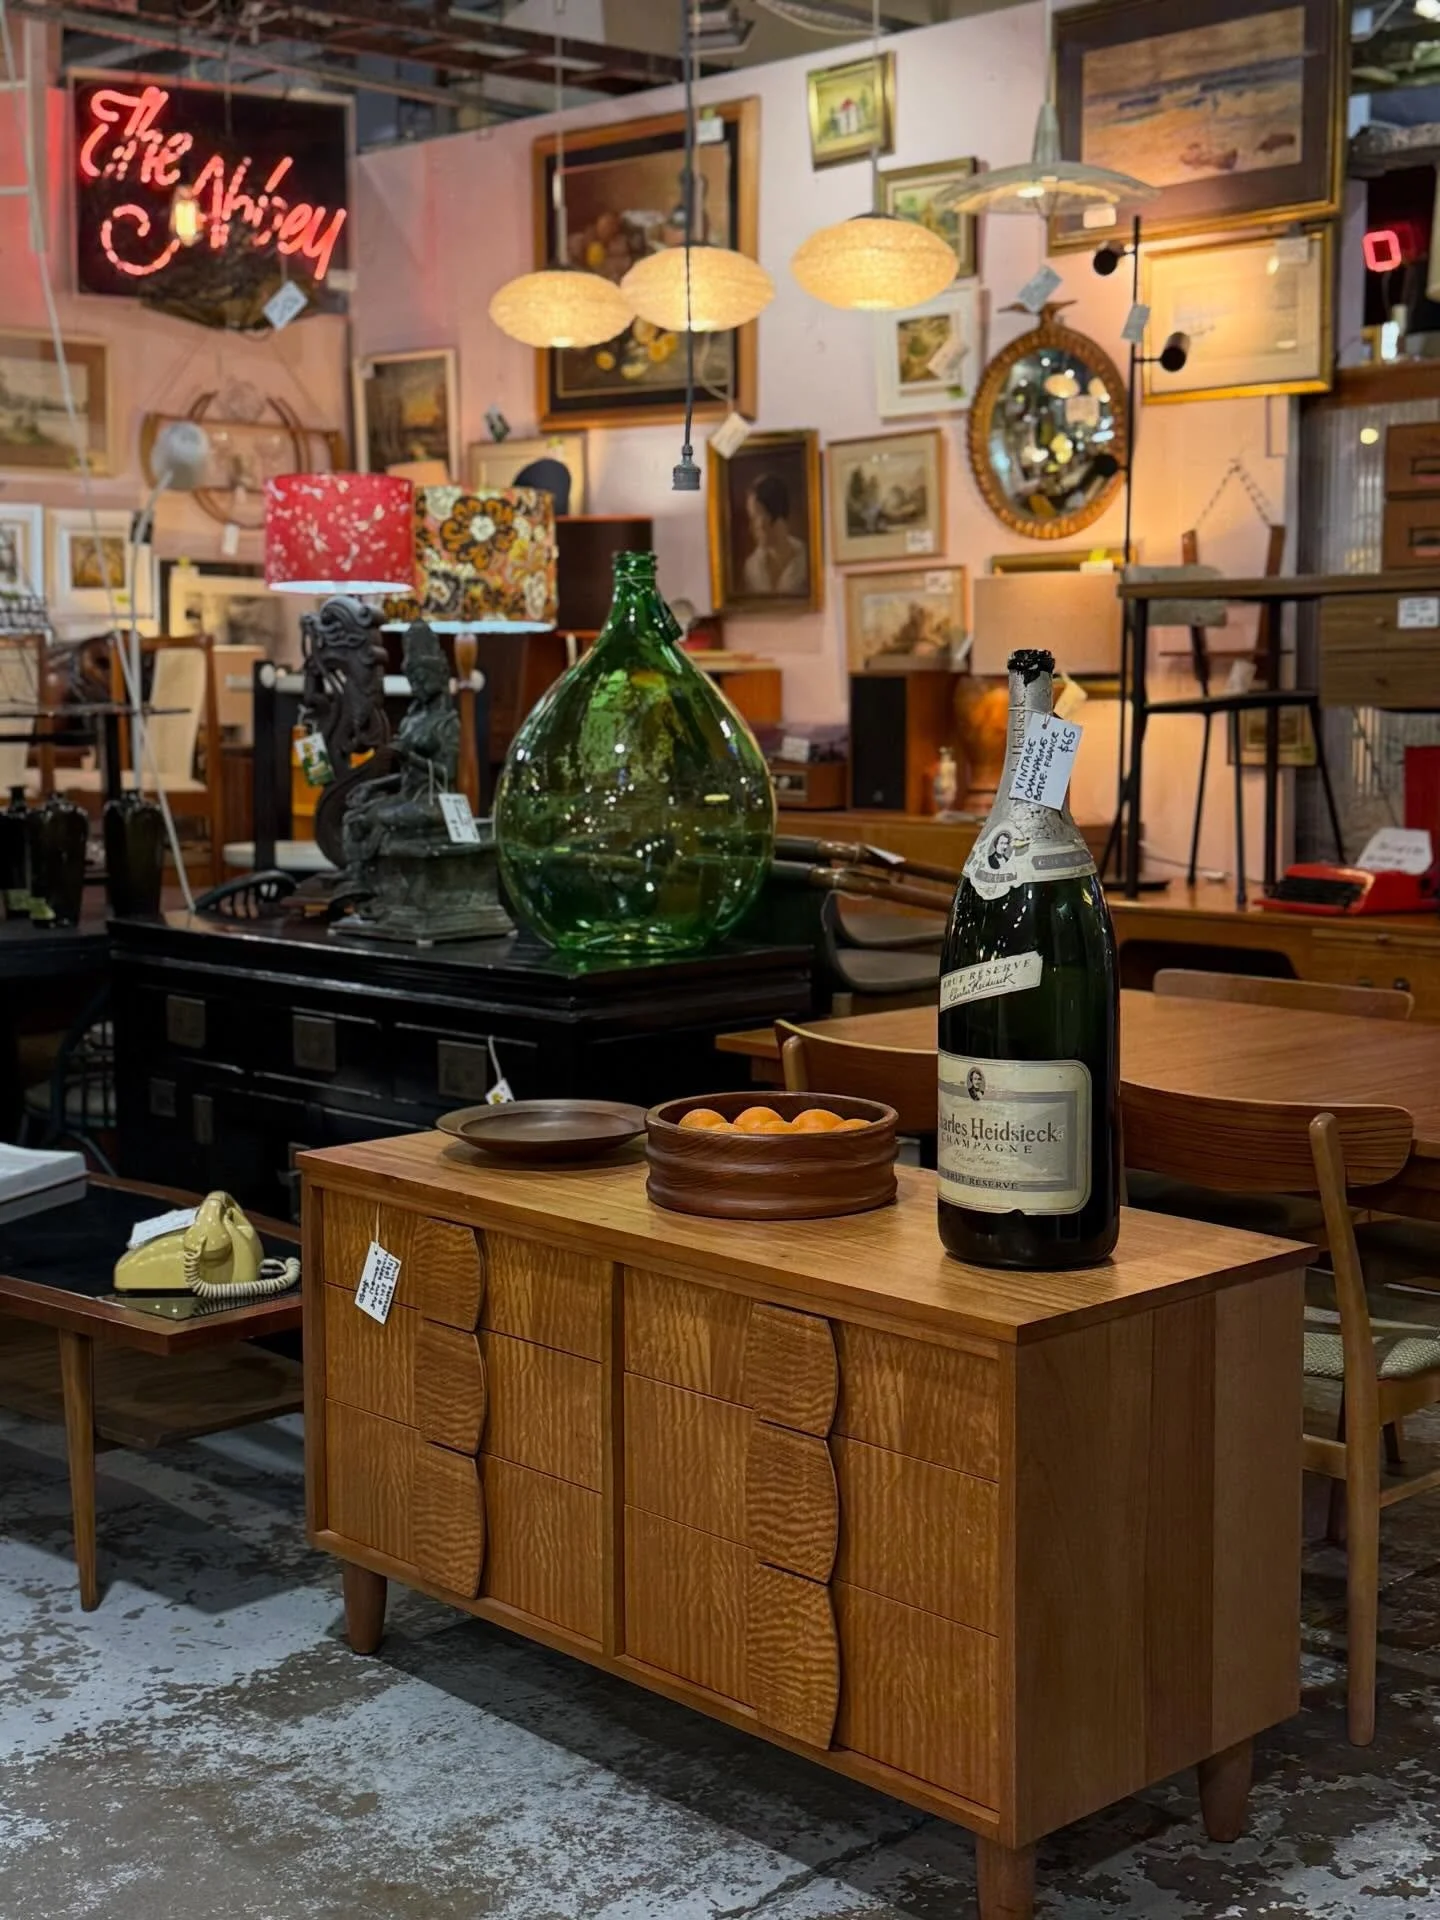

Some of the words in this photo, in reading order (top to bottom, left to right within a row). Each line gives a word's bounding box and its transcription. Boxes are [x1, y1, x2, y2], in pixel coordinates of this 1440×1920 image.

[80, 86, 194, 186] The
[1043, 731, 1059, 768] FRANCE
[1058, 727, 1076, 754] $65
[1015, 738, 1037, 790] VINTAGE
[1024, 737, 1048, 799] CHAMPAGNE
[939, 1113, 968, 1137] harles
[970, 1117, 1058, 1143] Heidsieck
[941, 1132, 1033, 1154] CHAMPAGNE
[969, 1177, 1019, 1190] RESERVE
